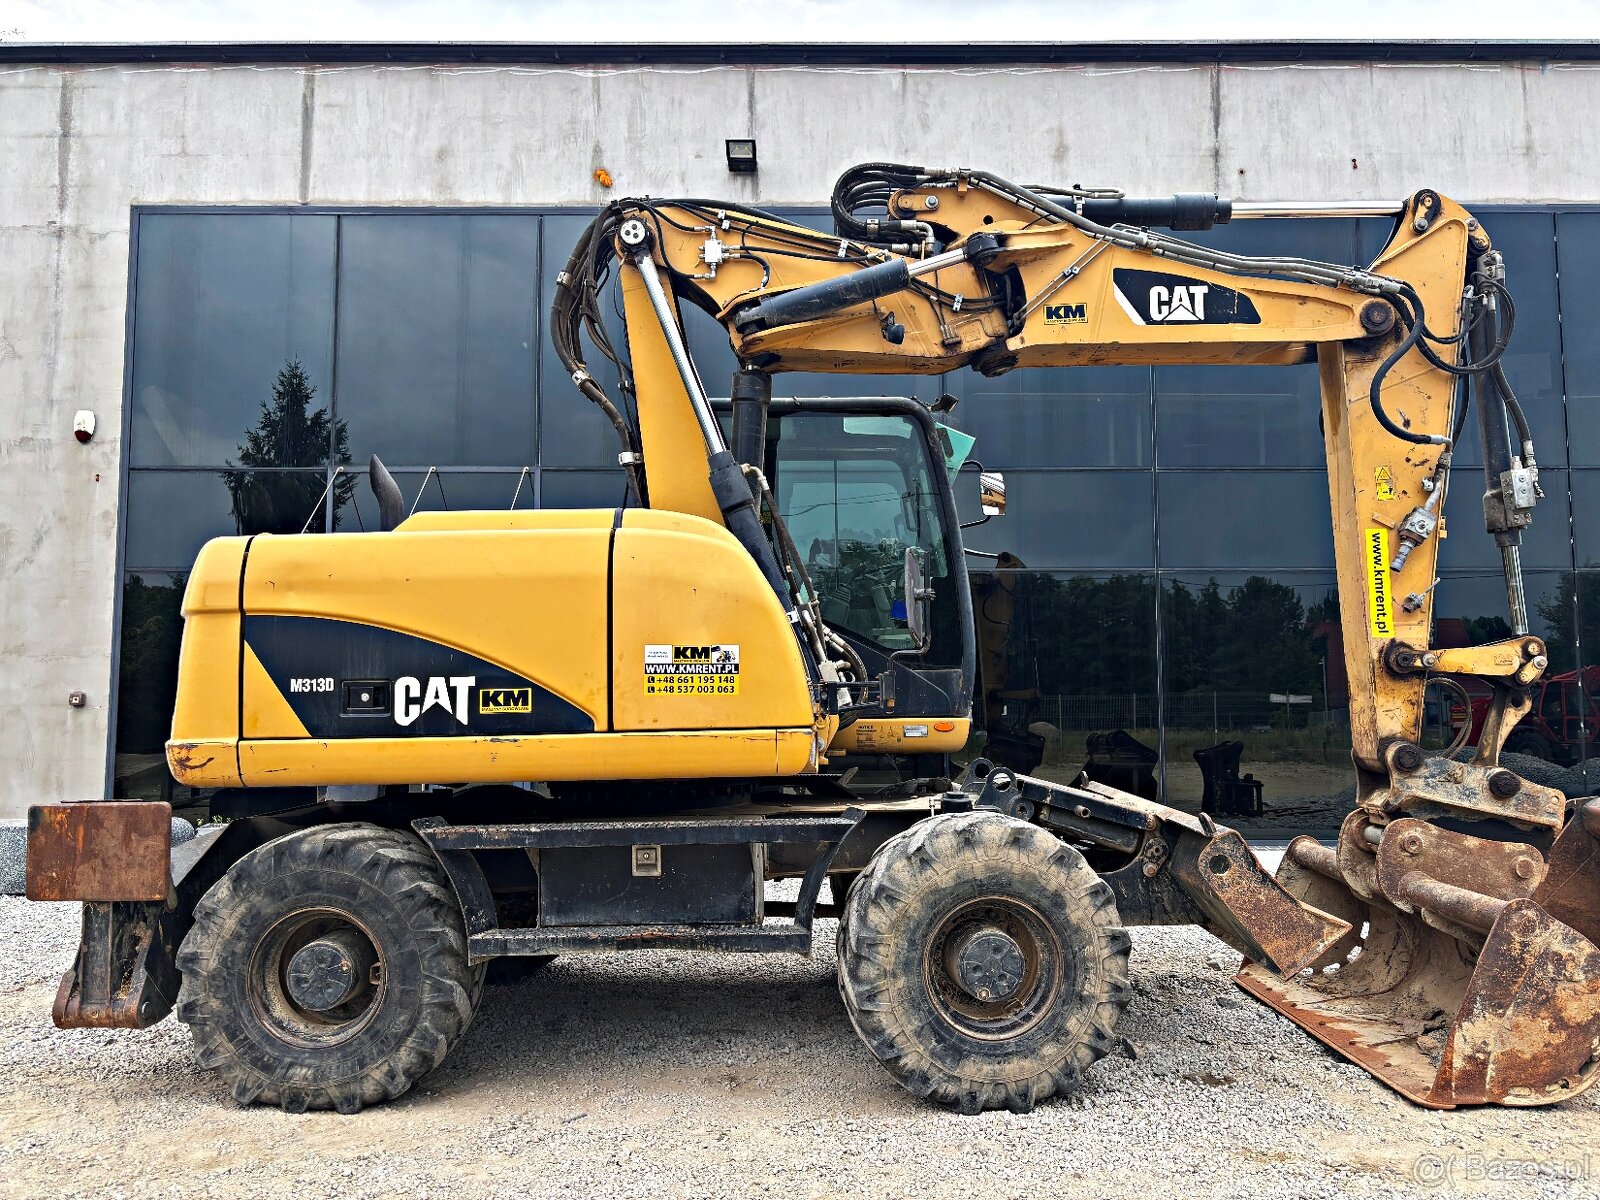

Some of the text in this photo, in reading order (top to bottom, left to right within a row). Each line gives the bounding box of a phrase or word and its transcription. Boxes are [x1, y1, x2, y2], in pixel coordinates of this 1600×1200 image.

[1046, 304, 1086, 319] KM
[1149, 285, 1209, 322] CAT
[1372, 532, 1390, 634] www.kmrent.pl
[674, 647, 710, 659] KM
[645, 664, 739, 674] WWW.KMRENT.PL
[290, 677, 335, 693] M313D
[394, 675, 476, 727] CAT
[481, 689, 529, 707] KM
